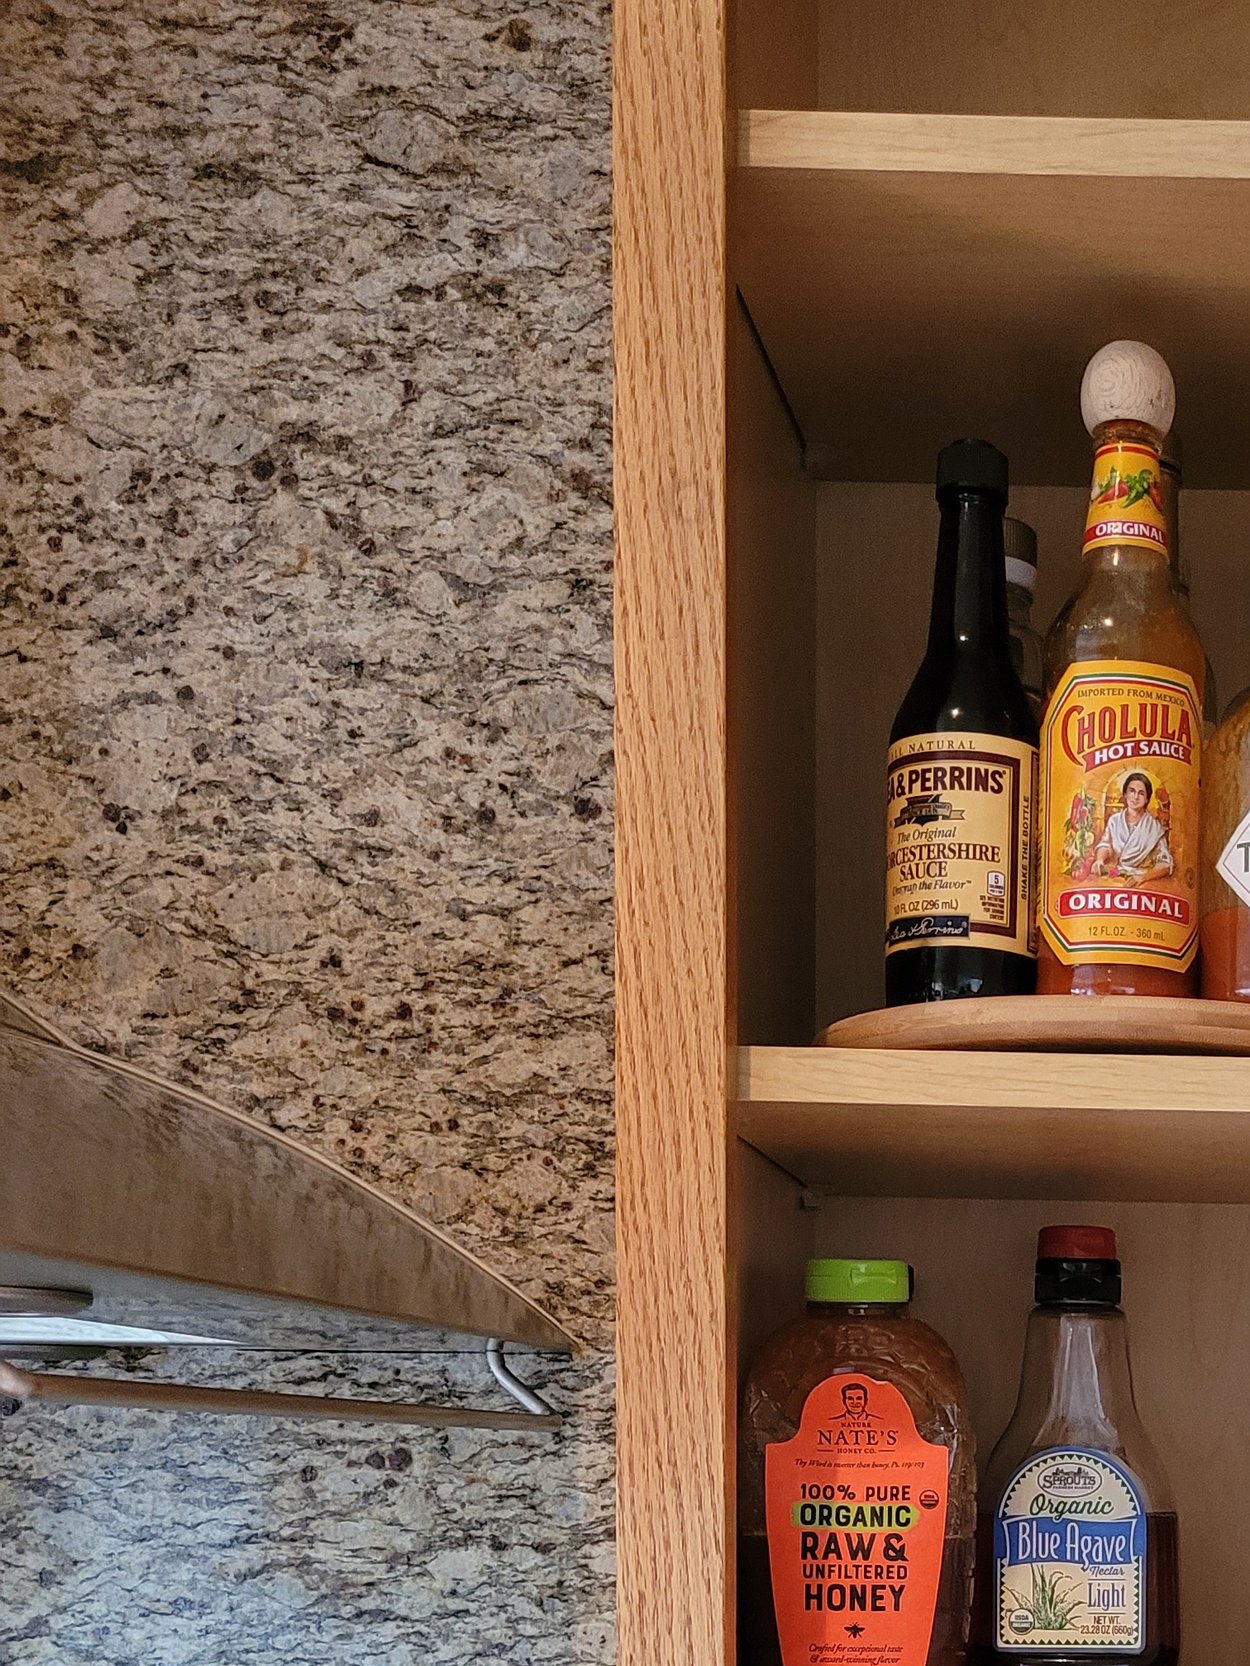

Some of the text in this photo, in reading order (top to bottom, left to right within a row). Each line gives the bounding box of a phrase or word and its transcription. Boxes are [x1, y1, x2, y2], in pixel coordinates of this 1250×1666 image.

[1095, 521, 1164, 543] ORIGINAL
[1077, 688, 1185, 706] IMPORTED FROM MEXICO
[1061, 703, 1193, 767] CHOLULA
[908, 739, 976, 754] NATURAL
[1094, 741, 1185, 765] HOT SAUCE
[898, 826, 957, 844] The Original
[900, 861, 948, 882] SAUCE
[994, 874, 1000, 884] 5
[918, 881, 932, 890] the
[908, 901, 920, 912] OZ
[941, 899, 958, 910] mL)
[1068, 893, 1183, 918] ORIGINAL
[1088, 926, 1098, 936] 12
[1136, 927, 1152, 939] 360
[1153, 931, 1166, 941] mL
[817, 1429, 897, 1446] NATE'S
[1042, 1475, 1096, 1489] SPROUTS
[801, 1483, 911, 1501] 100% PURE
[800, 1503, 911, 1527] ORGANIC
[1030, 1493, 1114, 1520] Organic
[801, 1531, 910, 1562] RAW &
[1018, 1520, 1126, 1572] Blue Agave
[802, 1564, 908, 1580] UNFILTERED
[1089, 1566, 1125, 1578] Nectar
[804, 1583, 906, 1612] HONEY
[1087, 1582, 1126, 1611] Light
[1093, 1615, 1121, 1625] NET WT.
[1080, 1625, 1100, 1635] 23.28
[1101, 1625, 1111, 1635] OZ
[809, 1643, 836, 1654] Crafted
[834, 1643, 847, 1654] for
